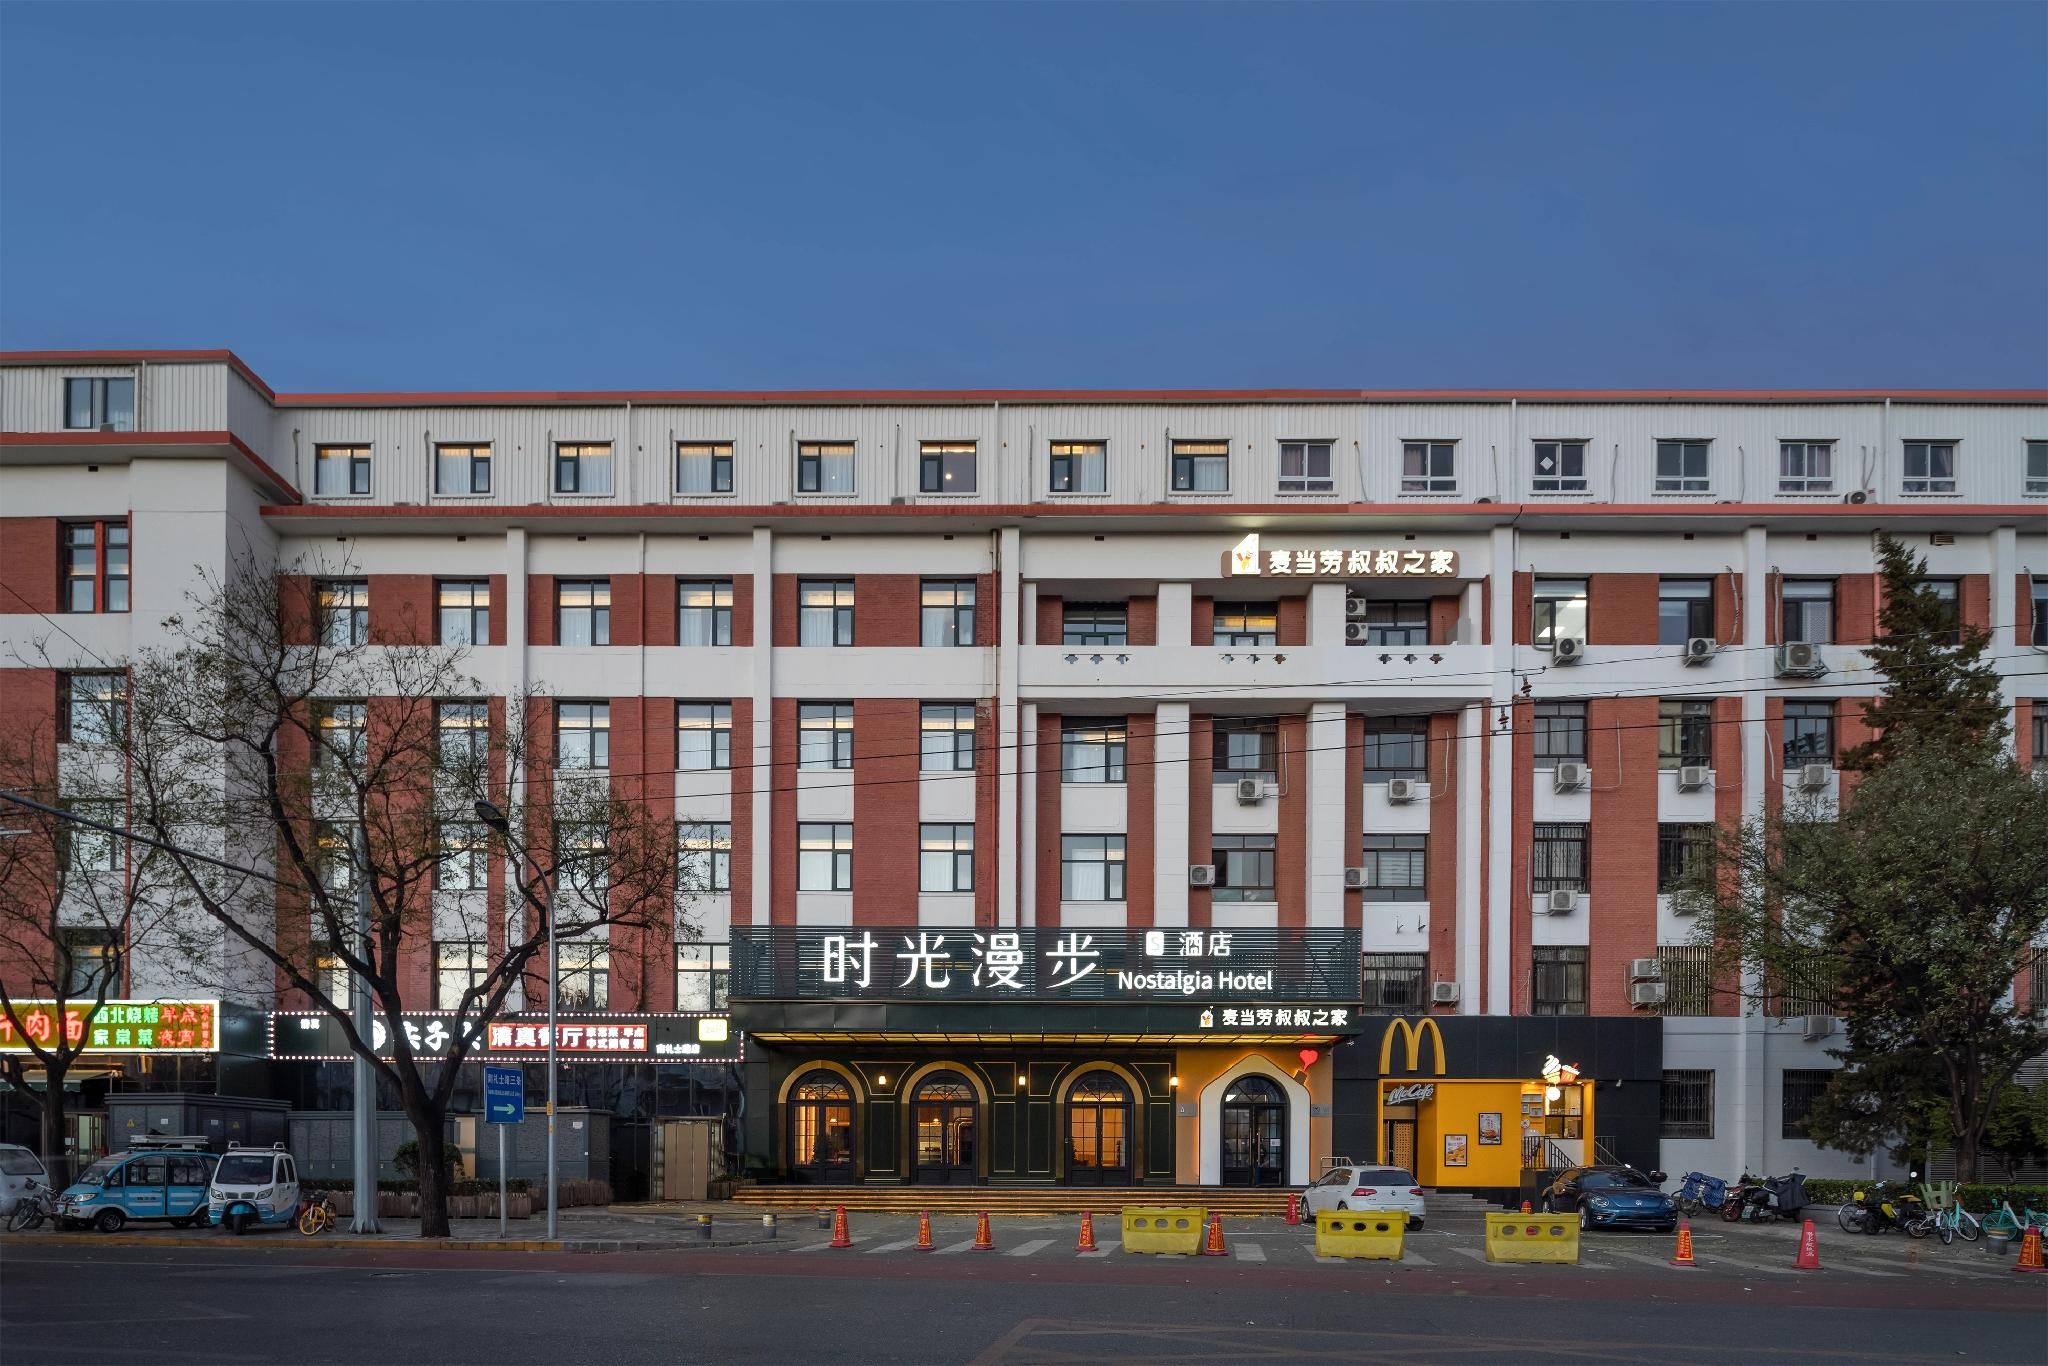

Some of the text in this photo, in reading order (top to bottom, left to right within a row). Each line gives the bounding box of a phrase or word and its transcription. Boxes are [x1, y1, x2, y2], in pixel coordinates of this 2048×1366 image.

[1268, 549, 1455, 575] 麦当劳叔叔之家
[1178, 931, 1233, 957] 酒店
[822, 931, 1101, 989] 时光漫步
[1118, 969, 1273, 995] Nostalgia Hotel
[160, 1006, 198, 1024] 早点
[1221, 1007, 1348, 1027] 麦当劳叔叔之家
[93, 1029, 153, 1046] 家常菜
